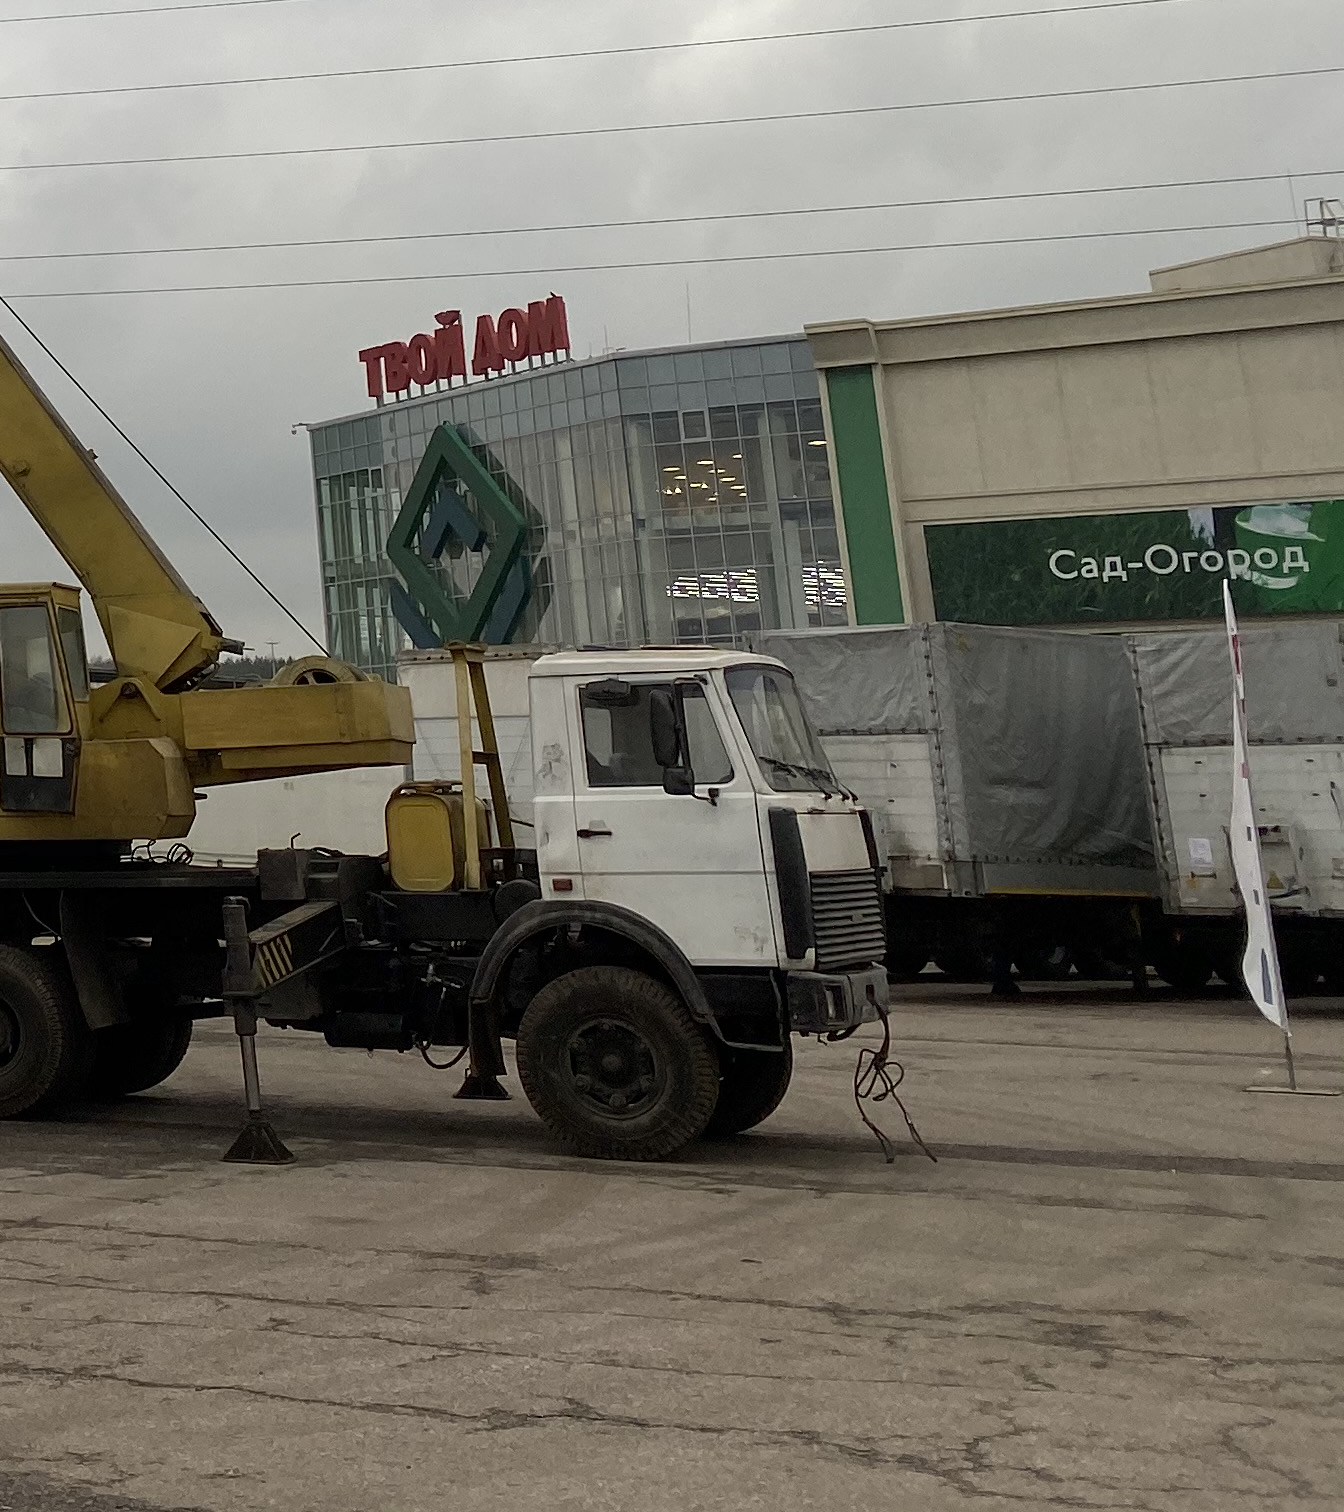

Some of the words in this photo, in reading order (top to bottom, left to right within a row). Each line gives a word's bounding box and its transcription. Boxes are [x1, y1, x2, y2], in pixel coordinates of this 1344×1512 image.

[359, 310, 467, 398] ТВОЙ
[472, 296, 571, 376] ДОМ
[1049, 543, 1310, 583] Сад-Огород
